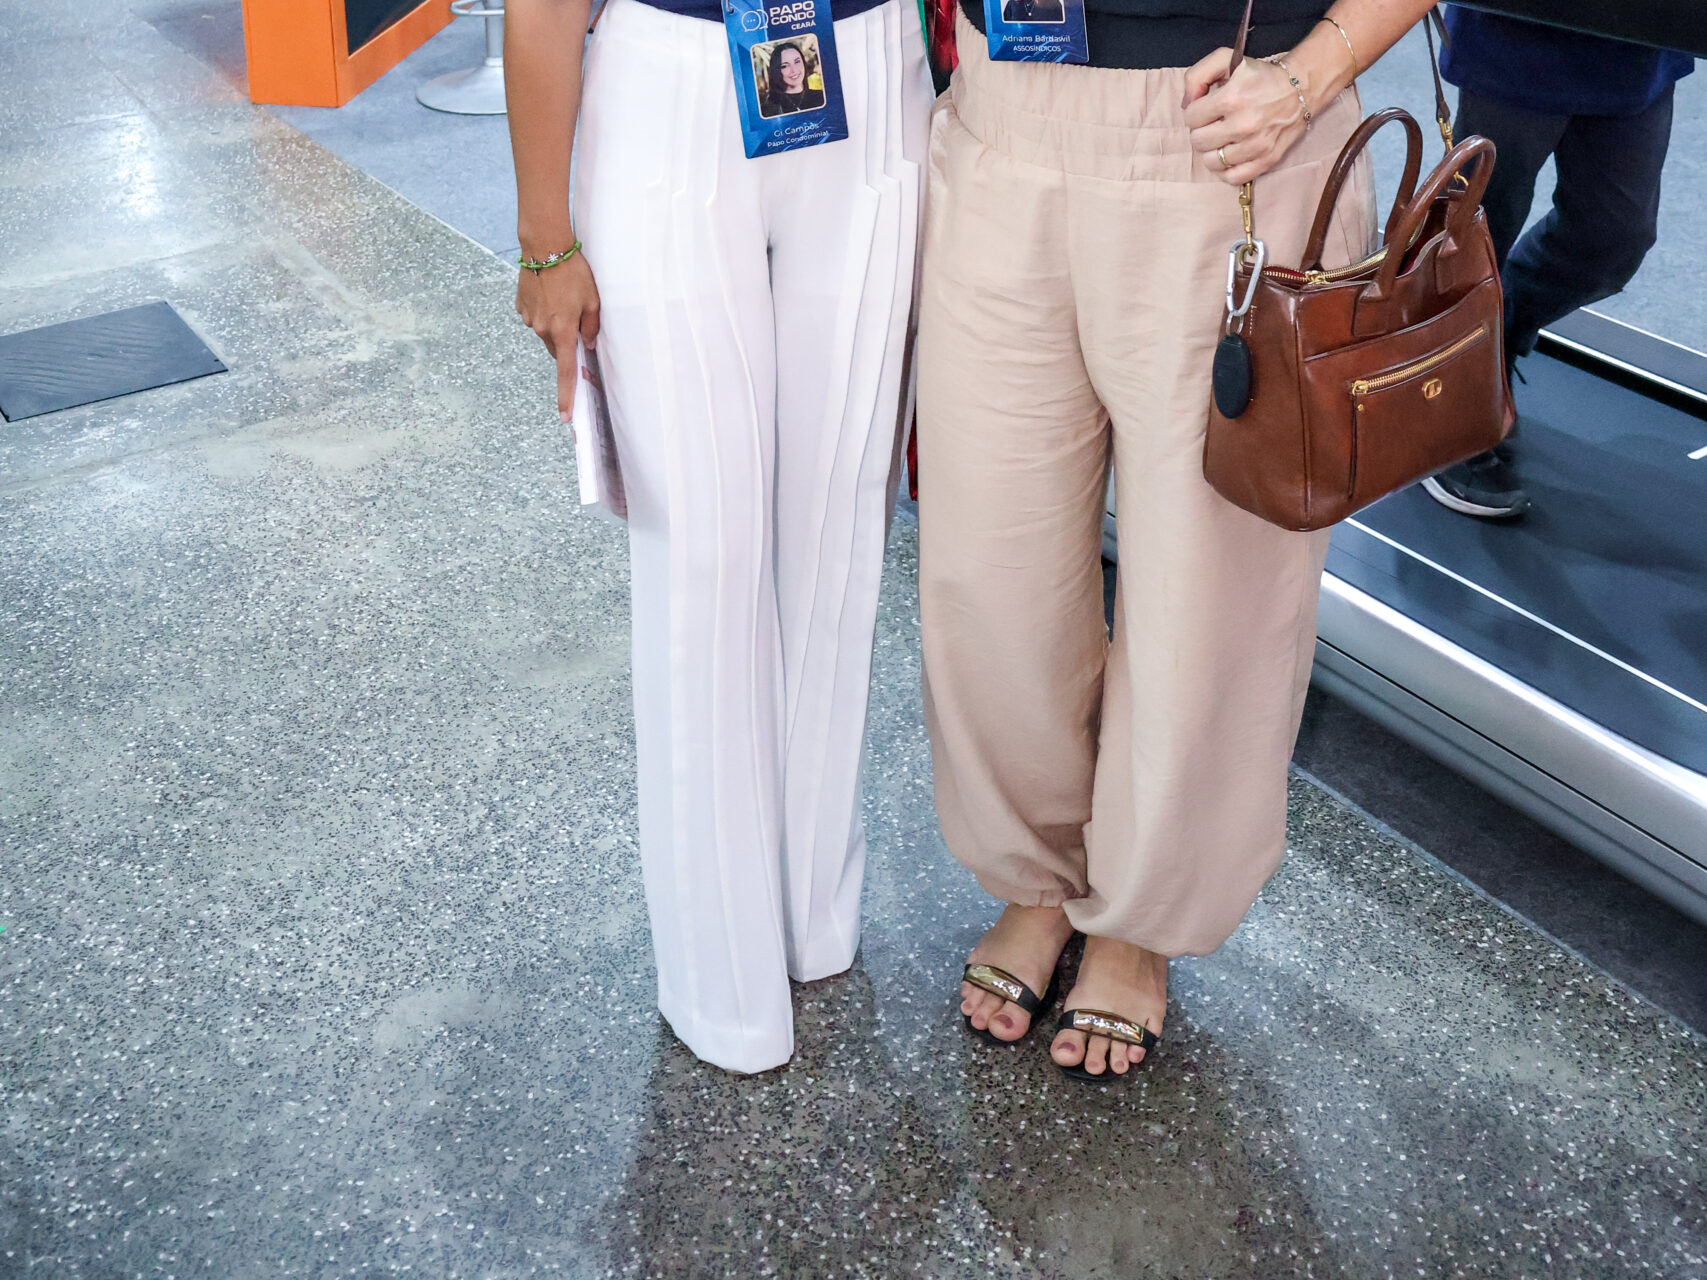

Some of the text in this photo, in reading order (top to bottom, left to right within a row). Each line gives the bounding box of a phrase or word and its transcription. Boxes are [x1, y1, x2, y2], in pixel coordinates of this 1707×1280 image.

[769, 0, 815, 17] PAPO
[770, 10, 816, 26] CONDO
[791, 19, 817, 30] CEARÁ
[767, 140, 785, 148] Papo
